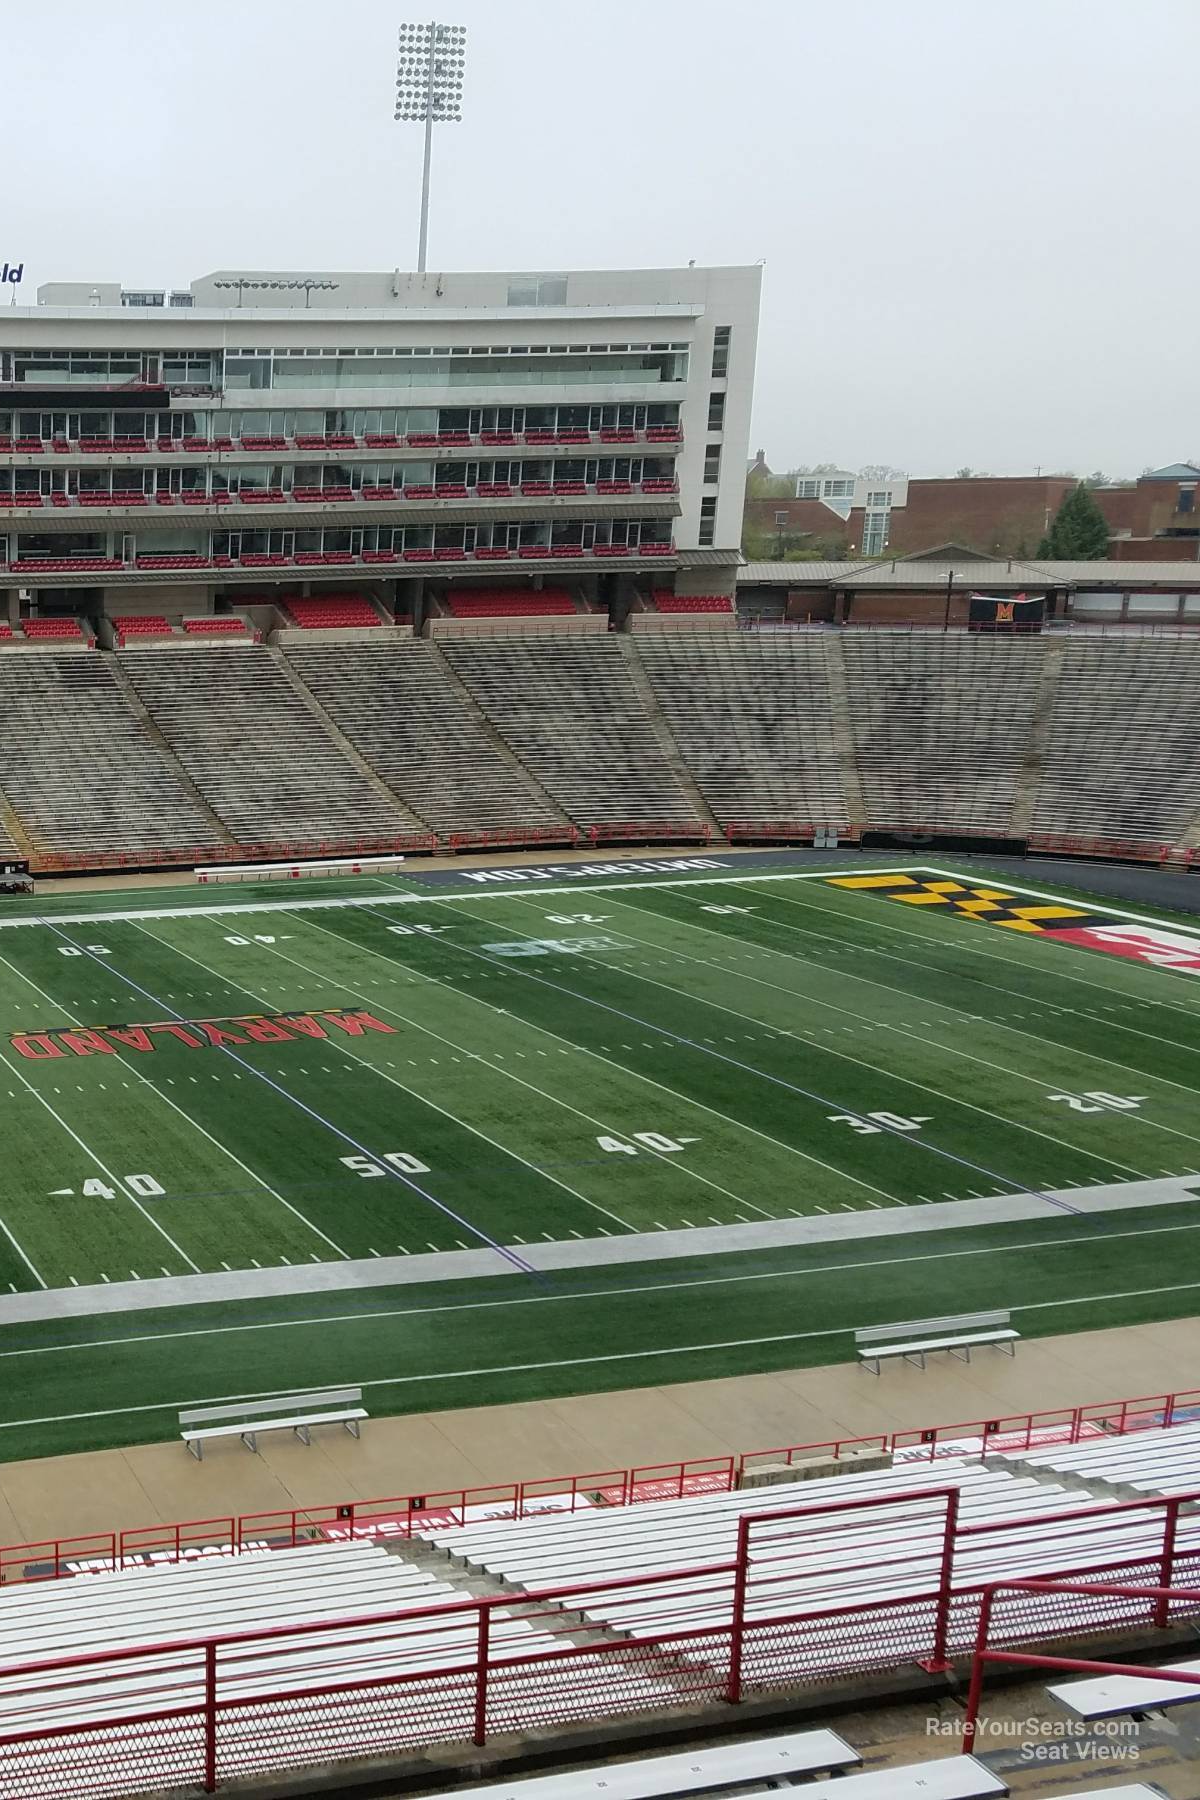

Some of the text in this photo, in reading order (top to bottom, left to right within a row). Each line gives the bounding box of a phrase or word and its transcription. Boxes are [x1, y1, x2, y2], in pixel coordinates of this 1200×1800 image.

[996, 603, 1014, 621] M
[460, 859, 732, 883] UMTERPS.COM
[386, 923, 447, 935] 30
[544, 913, 603, 924] 20
[57, 944, 113, 956] 50
[223, 935, 277, 947] 40
[8, 1011, 402, 1061] MARYLAND
[1045, 1091, 1142, 1113] 20
[826, 1111, 923, 1135] 30
[596, 1132, 685, 1156] 40
[338, 1152, 432, 1178] 50
[82, 1173, 167, 1200] 40
[326, 1516, 460, 1543] NISSAN
